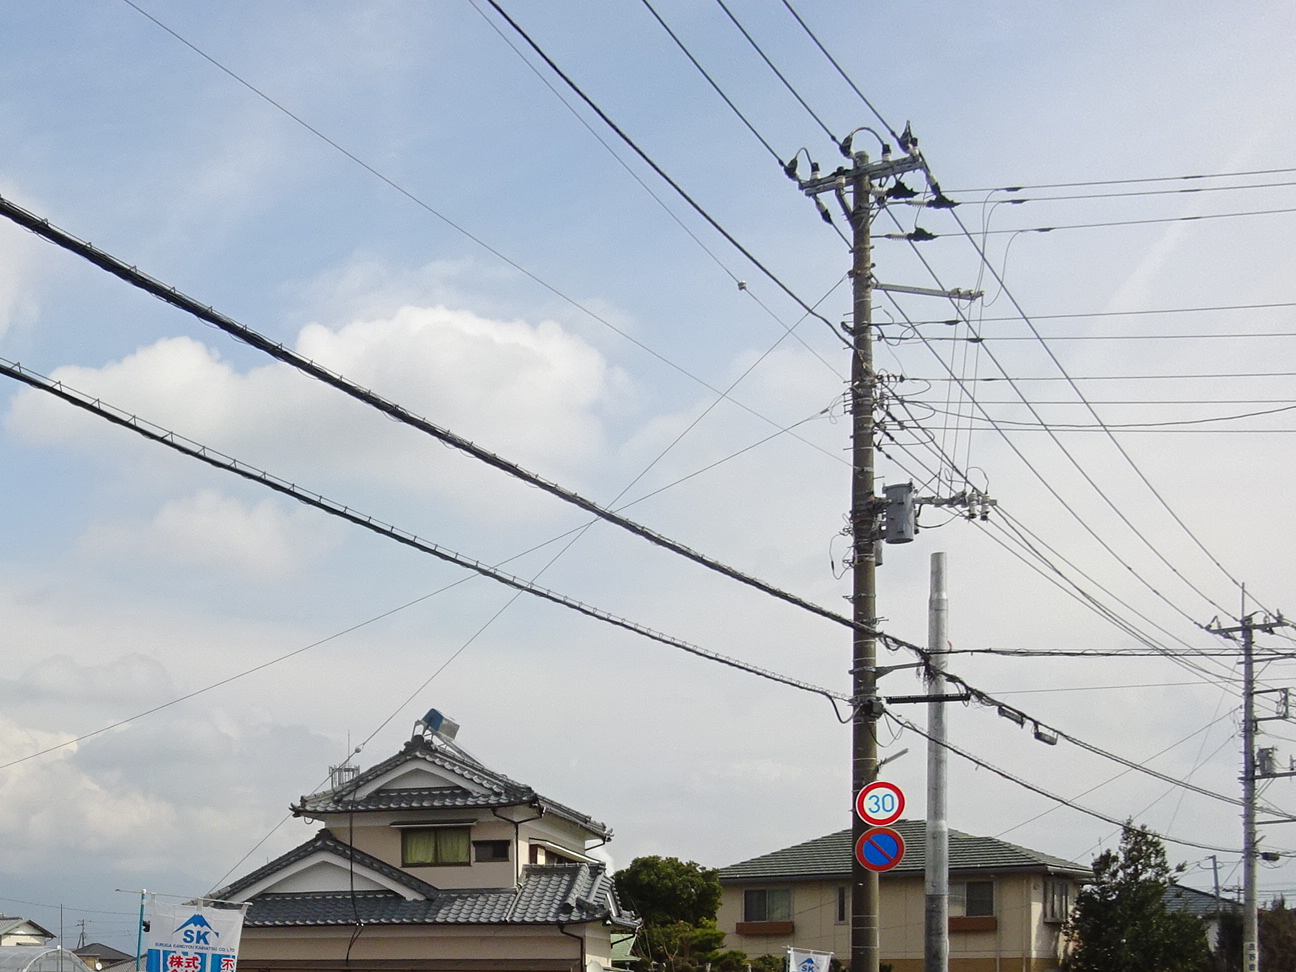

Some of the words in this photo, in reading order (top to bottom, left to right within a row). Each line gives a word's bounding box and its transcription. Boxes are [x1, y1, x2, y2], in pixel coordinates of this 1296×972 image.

[868, 793, 894, 813] 30
[182, 929, 210, 945] SK
[168, 955, 201, 970] 株式
[801, 964, 815, 972] SK
